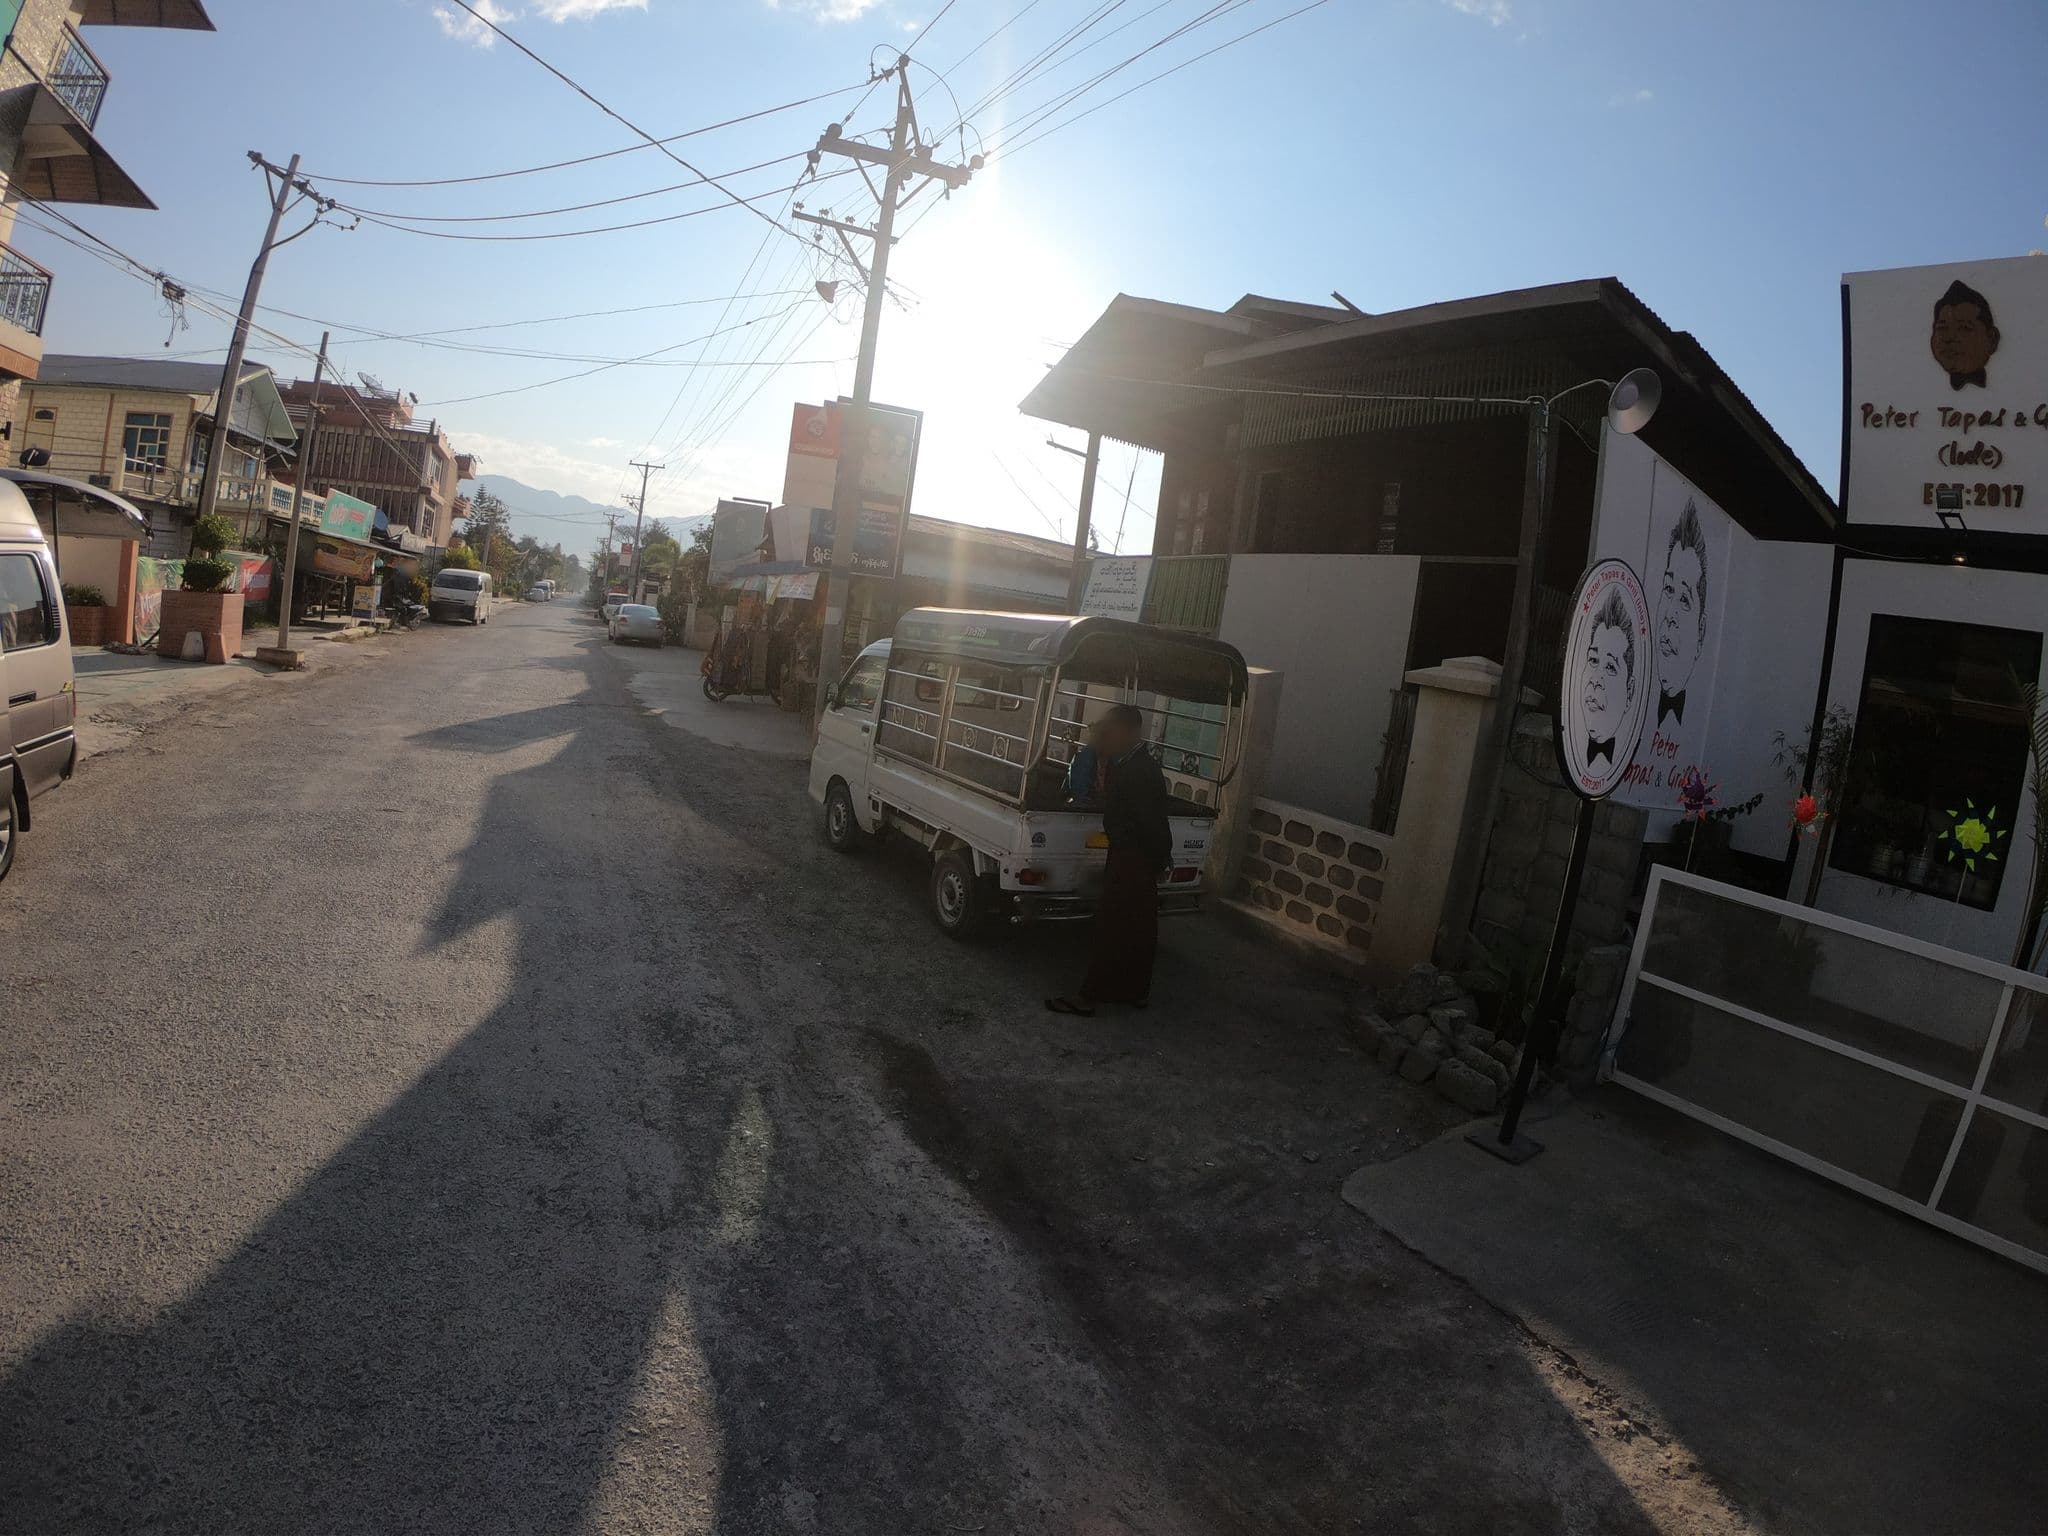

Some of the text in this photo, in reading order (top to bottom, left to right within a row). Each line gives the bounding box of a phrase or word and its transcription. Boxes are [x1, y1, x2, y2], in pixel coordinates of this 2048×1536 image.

[1861, 403, 1919, 428] Peter
[1937, 406, 2006, 434] Tapas
[2014, 408, 2026, 427] &
[1923, 482, 2024, 508] E:2017
[1586, 580, 1601, 603] Peter
[1600, 570, 1619, 581] Tapas
[1650, 731, 1680, 760] Peter
[1622, 761, 1654, 794] apas
